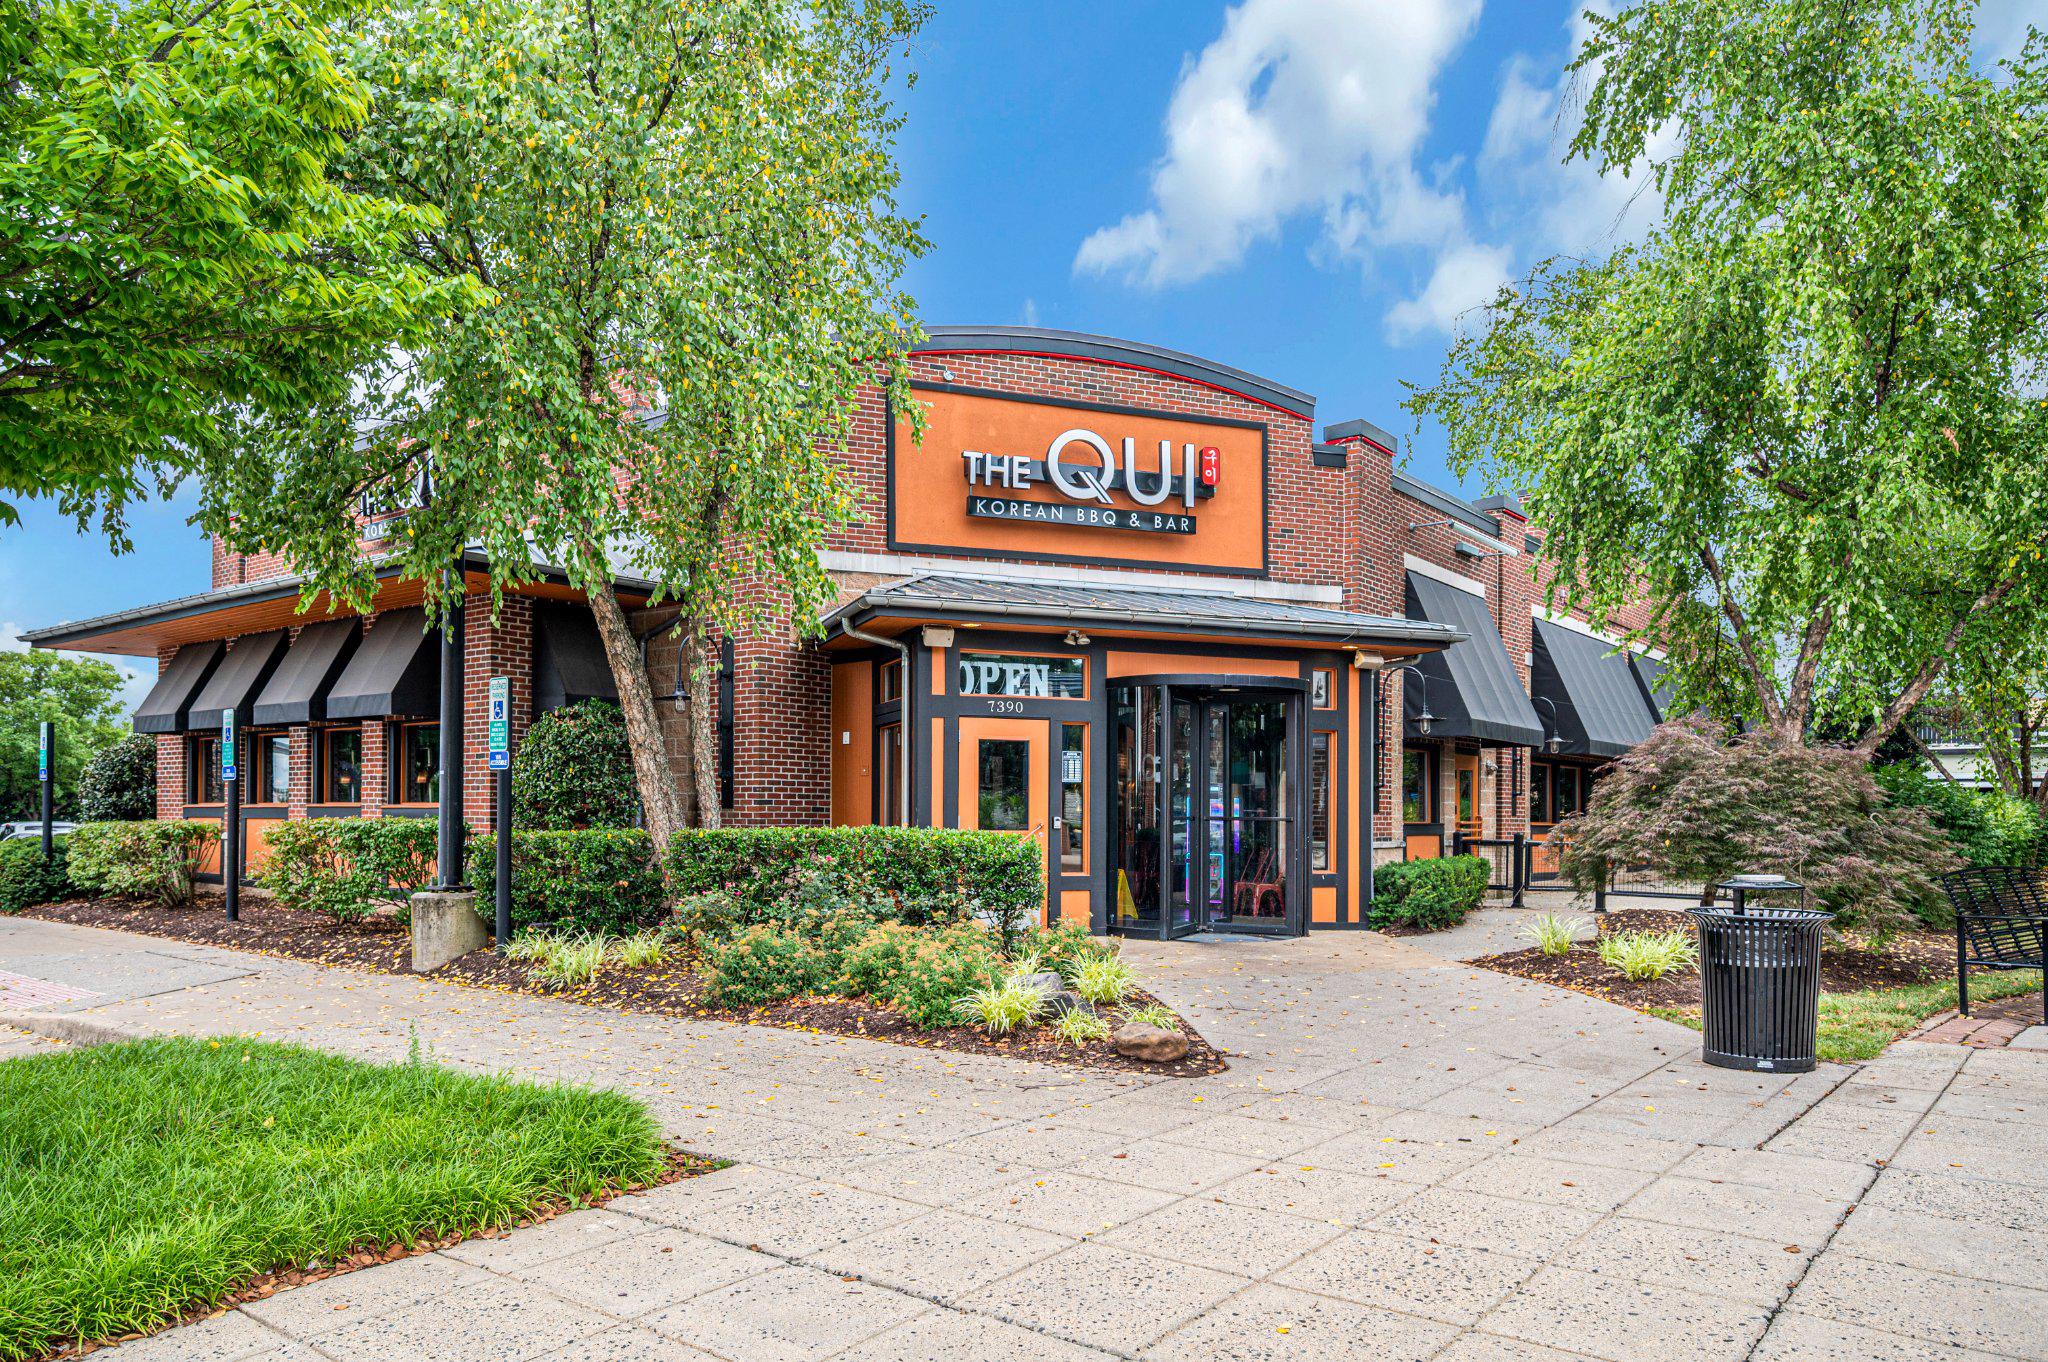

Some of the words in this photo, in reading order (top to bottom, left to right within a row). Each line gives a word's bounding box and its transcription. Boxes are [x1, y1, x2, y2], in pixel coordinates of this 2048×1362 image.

[962, 450, 1031, 490] THE
[1047, 429, 1195, 507] QUI
[976, 499, 1063, 521] KOREAN
[1077, 509, 1117, 527] BBQ
[1130, 512, 1141, 527] &
[1154, 515, 1189, 532] BAR
[960, 660, 1050, 698] OPEN
[988, 700, 1024, 713] 7390
